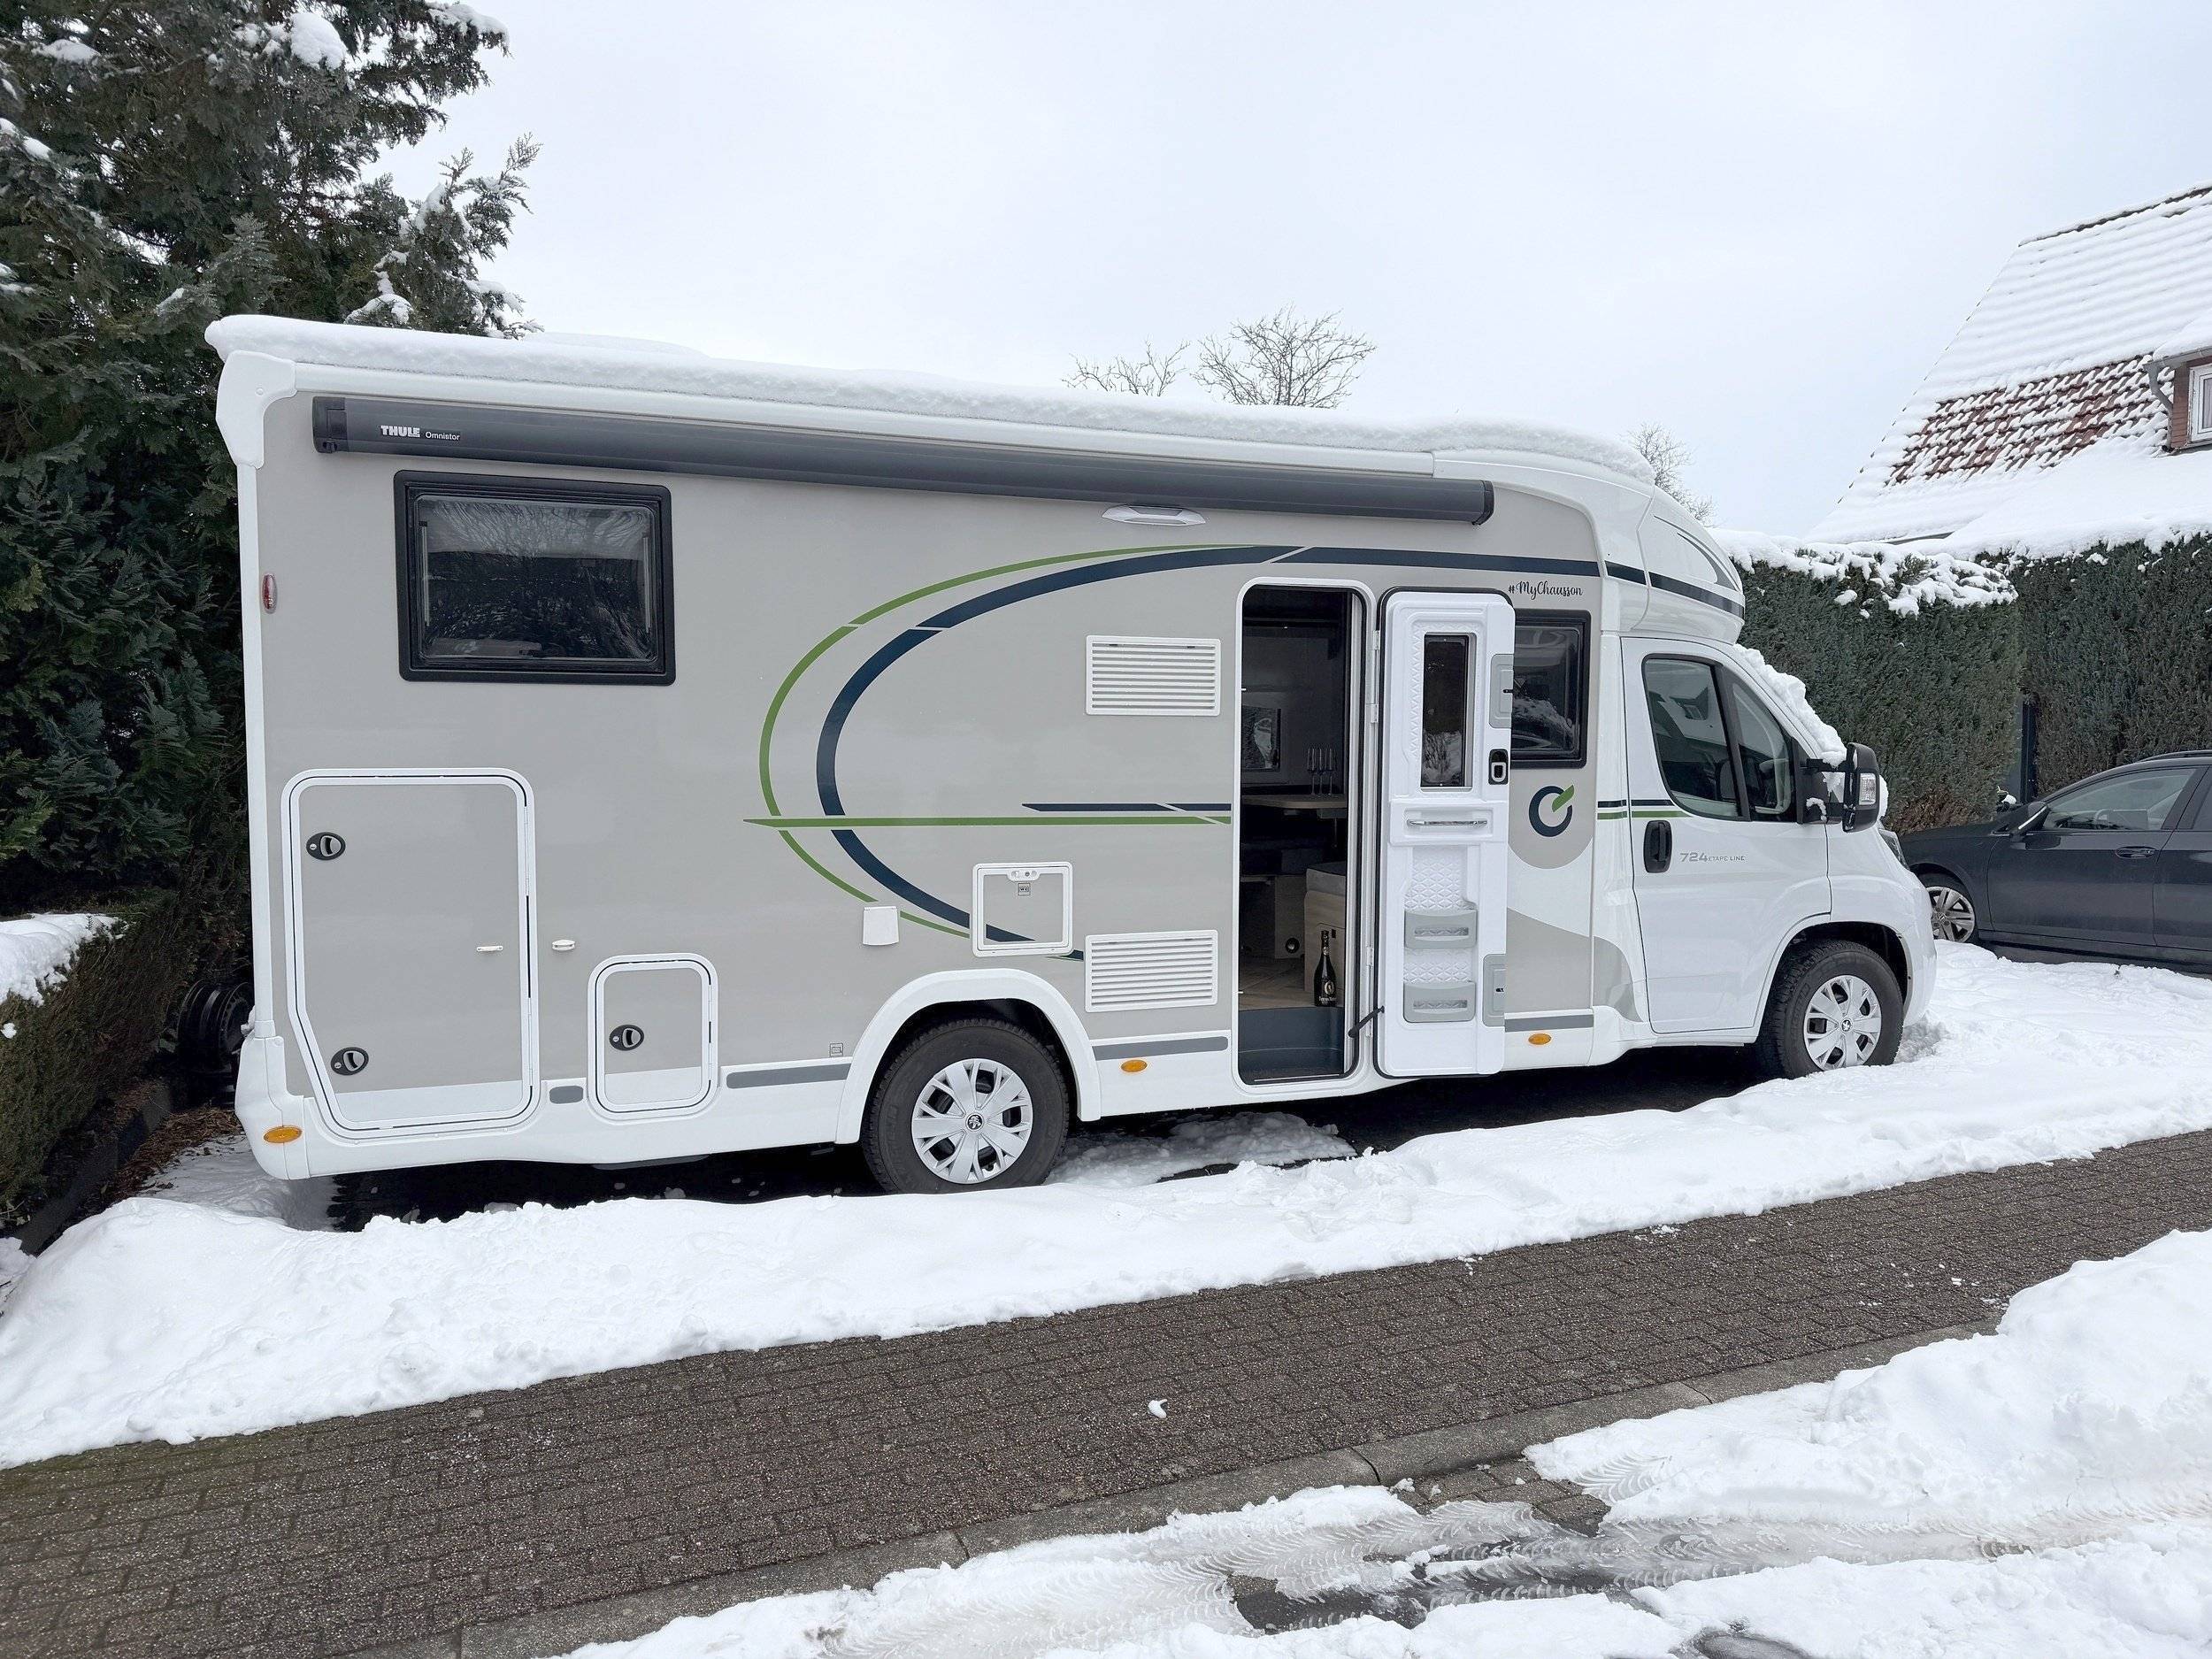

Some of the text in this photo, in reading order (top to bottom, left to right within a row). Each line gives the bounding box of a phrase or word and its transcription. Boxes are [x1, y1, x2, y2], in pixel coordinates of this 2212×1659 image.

[380, 425, 460, 441] THULE Omnistor
[1508, 580, 1583, 600] #MyChausson
[1679, 852, 1708, 862] 724
